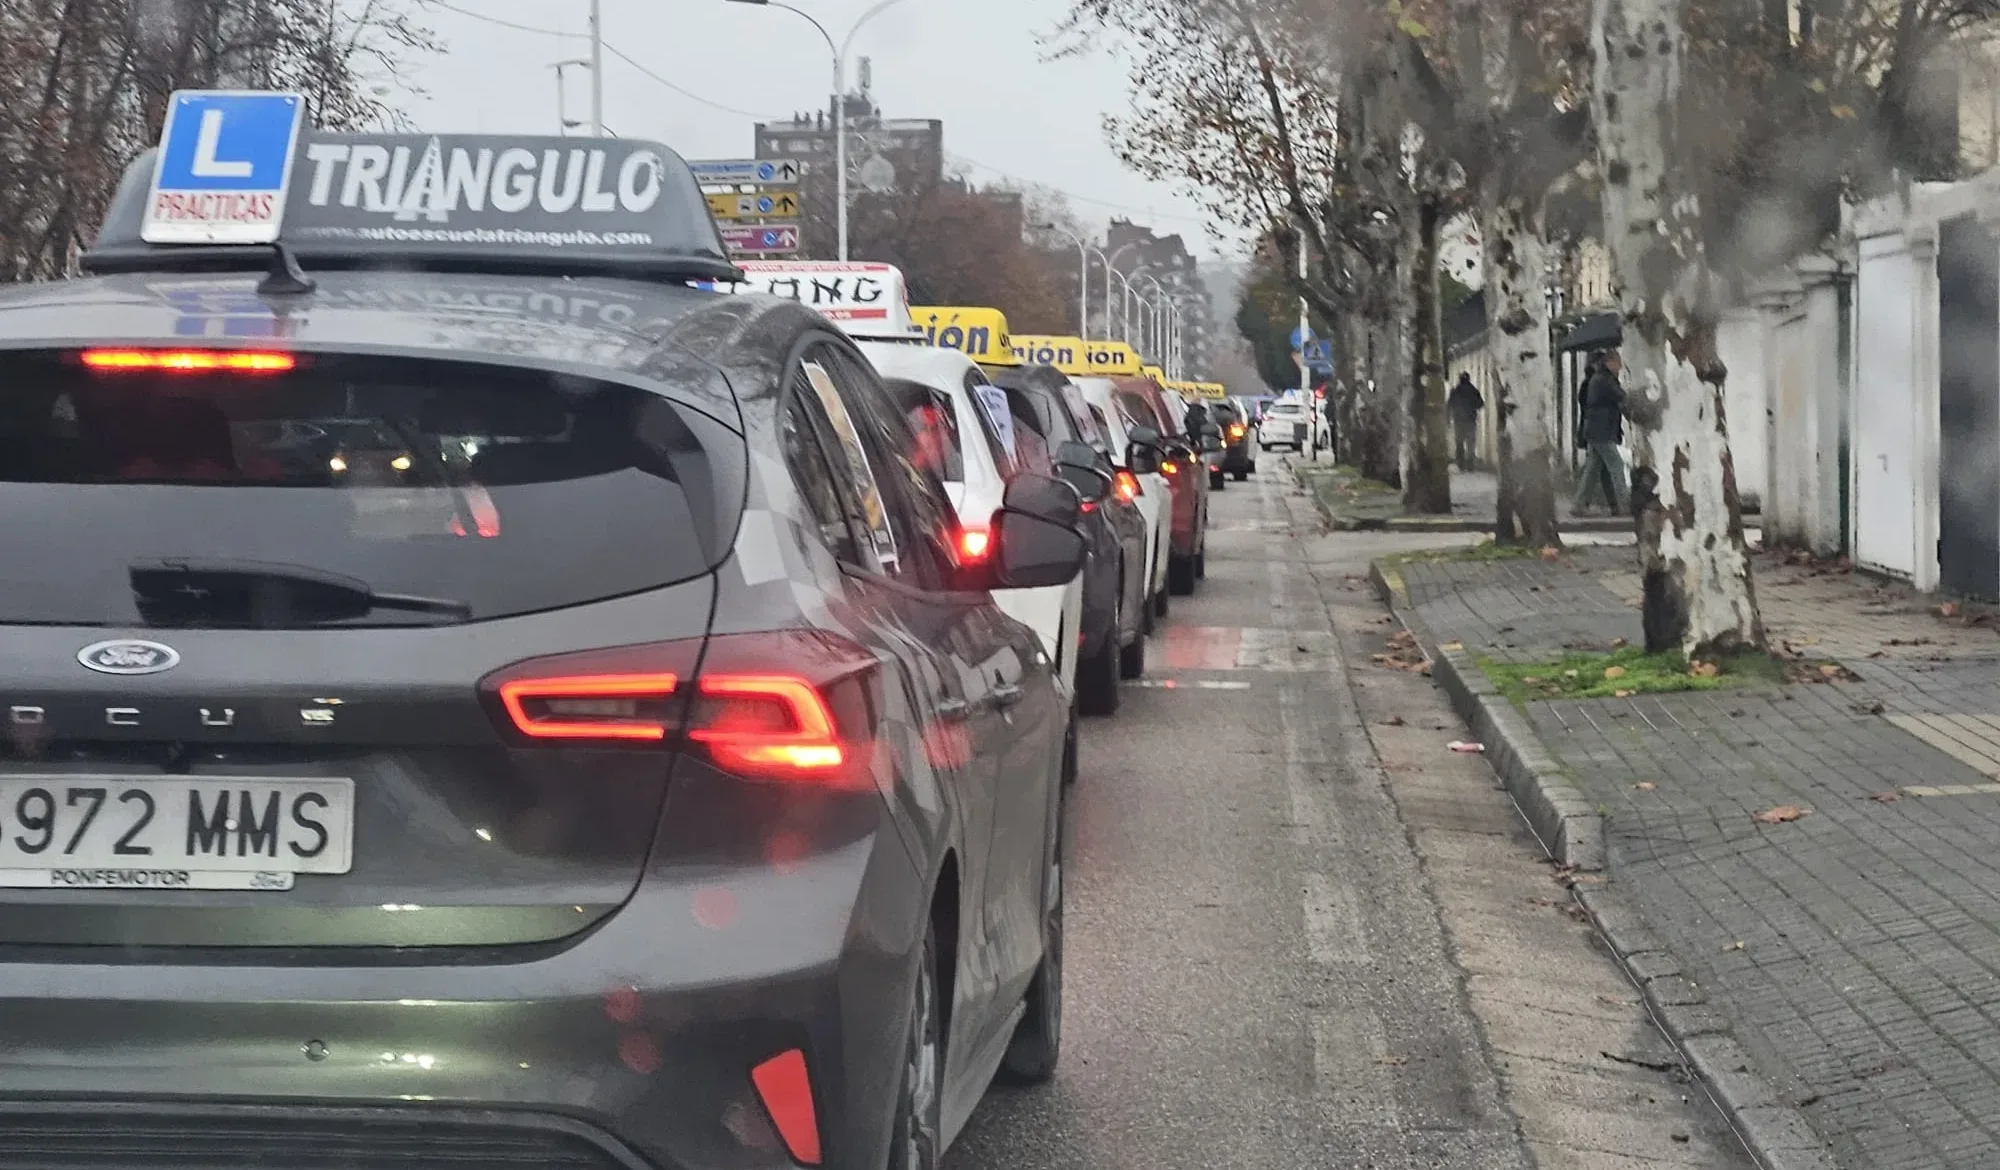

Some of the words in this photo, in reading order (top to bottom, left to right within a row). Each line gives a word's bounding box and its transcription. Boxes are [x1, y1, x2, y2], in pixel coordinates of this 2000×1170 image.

[191, 109, 253, 177] L
[0, 787, 155, 855] 972
[185, 789, 330, 858] MMS
[51, 869, 191, 886] PONFEMOTOR
